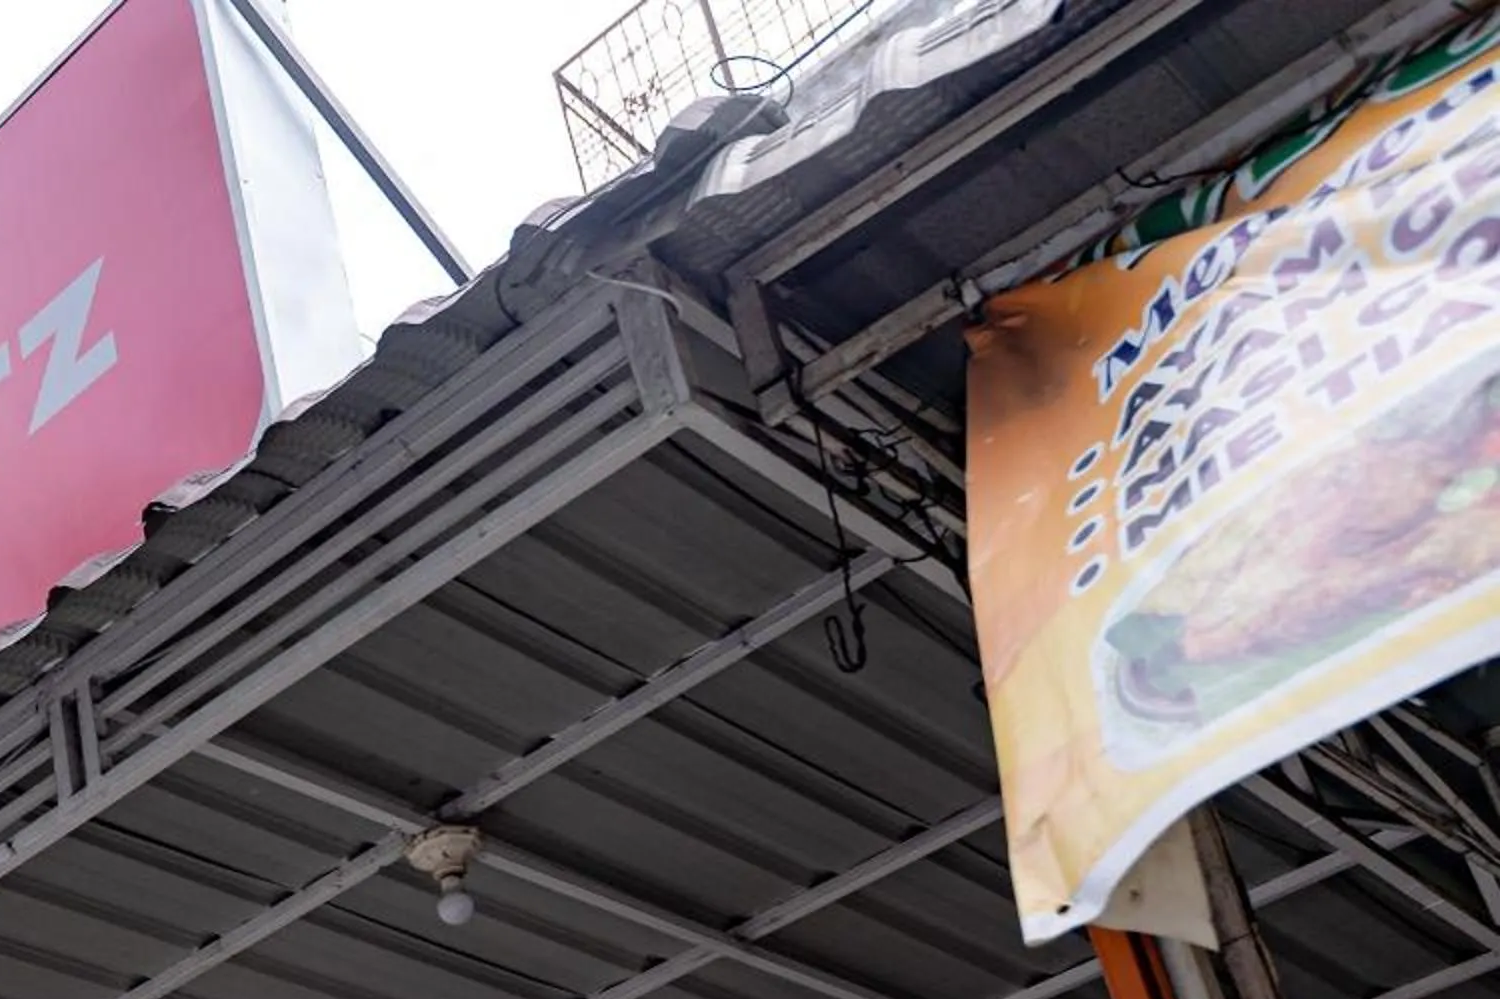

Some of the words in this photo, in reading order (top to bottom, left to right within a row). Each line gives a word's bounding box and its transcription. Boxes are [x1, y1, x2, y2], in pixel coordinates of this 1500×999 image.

[1118, 216, 1344, 438] AYAM
[1123, 260, 1368, 477] AYAM
[1125, 412, 1284, 551] MIE
[1306, 275, 1500, 405] TIA
[1125, 331, 1325, 509] NASI
